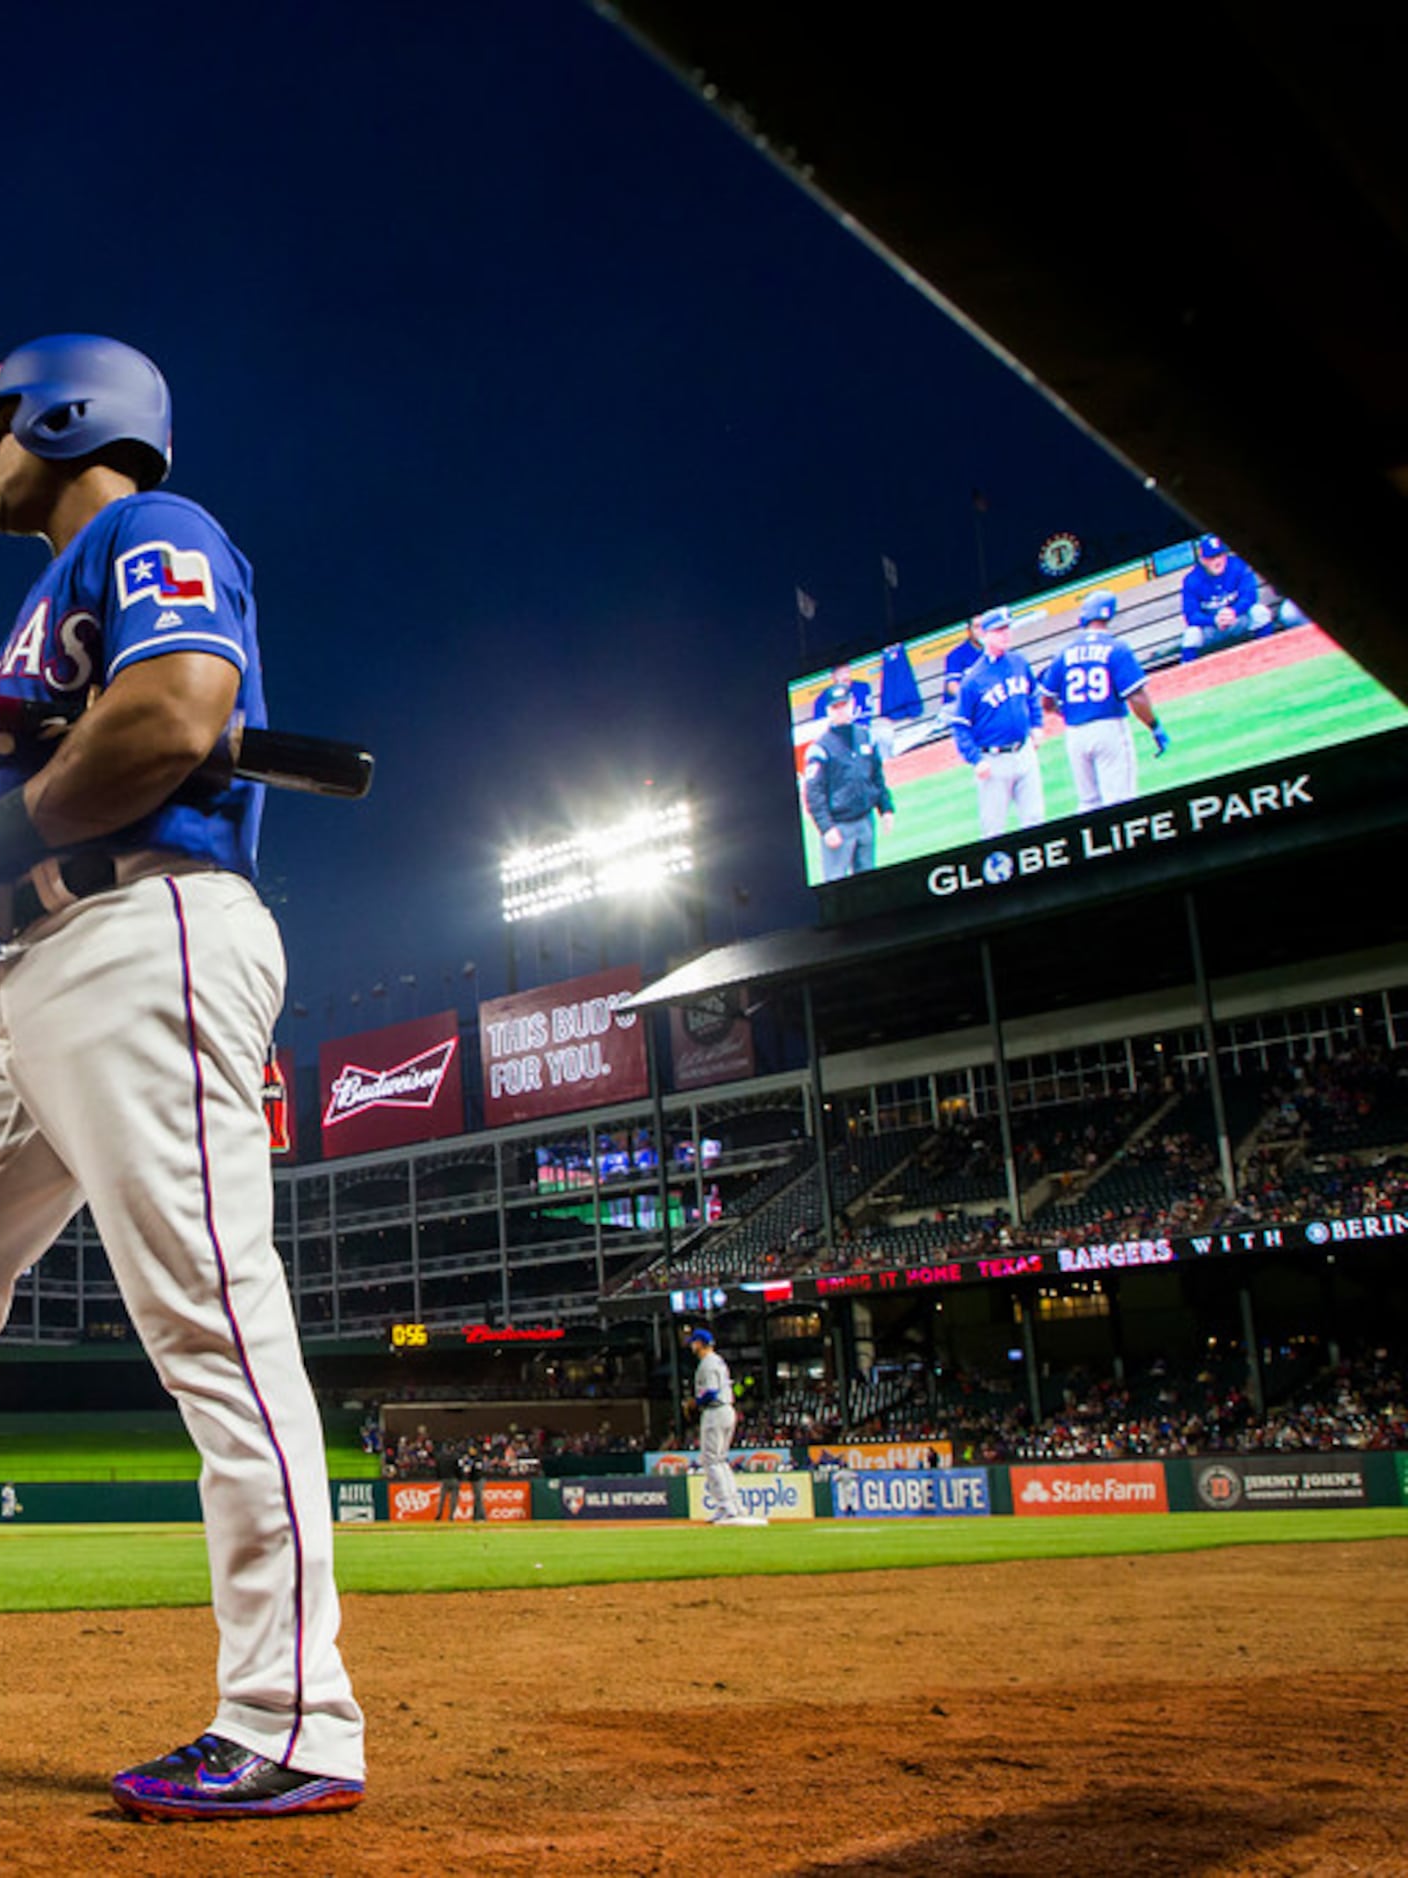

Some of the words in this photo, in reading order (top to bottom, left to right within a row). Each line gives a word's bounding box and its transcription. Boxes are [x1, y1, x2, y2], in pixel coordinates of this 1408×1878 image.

[1066, 667, 1110, 702] 29
[928, 838, 1072, 896] GLOBE
[1080, 810, 1179, 859] LIFE
[1188, 774, 1314, 832] PARK
[488, 1012, 548, 1058] THIS
[331, 1066, 442, 1109] Budweiser
[490, 1056, 543, 1099] FOR
[544, 1042, 611, 1086] YOU.
[879, 1271, 898, 1288] IT
[905, 1263, 961, 1286] HOME
[977, 1255, 1043, 1277] TEXAS
[1058, 1238, 1173, 1271] RANGERS
[1191, 1228, 1284, 1254] WITH
[461, 1324, 565, 1343] Budweiser
[586, 1492, 609, 1507] MLB
[612, 1491, 668, 1506] NETWORK
[863, 1479, 936, 1511] GLOBE
[939, 1477, 985, 1509] LIFE
[1244, 1474, 1299, 1491] JIMMY
[1301, 1471, 1362, 1489] JOHN'S
